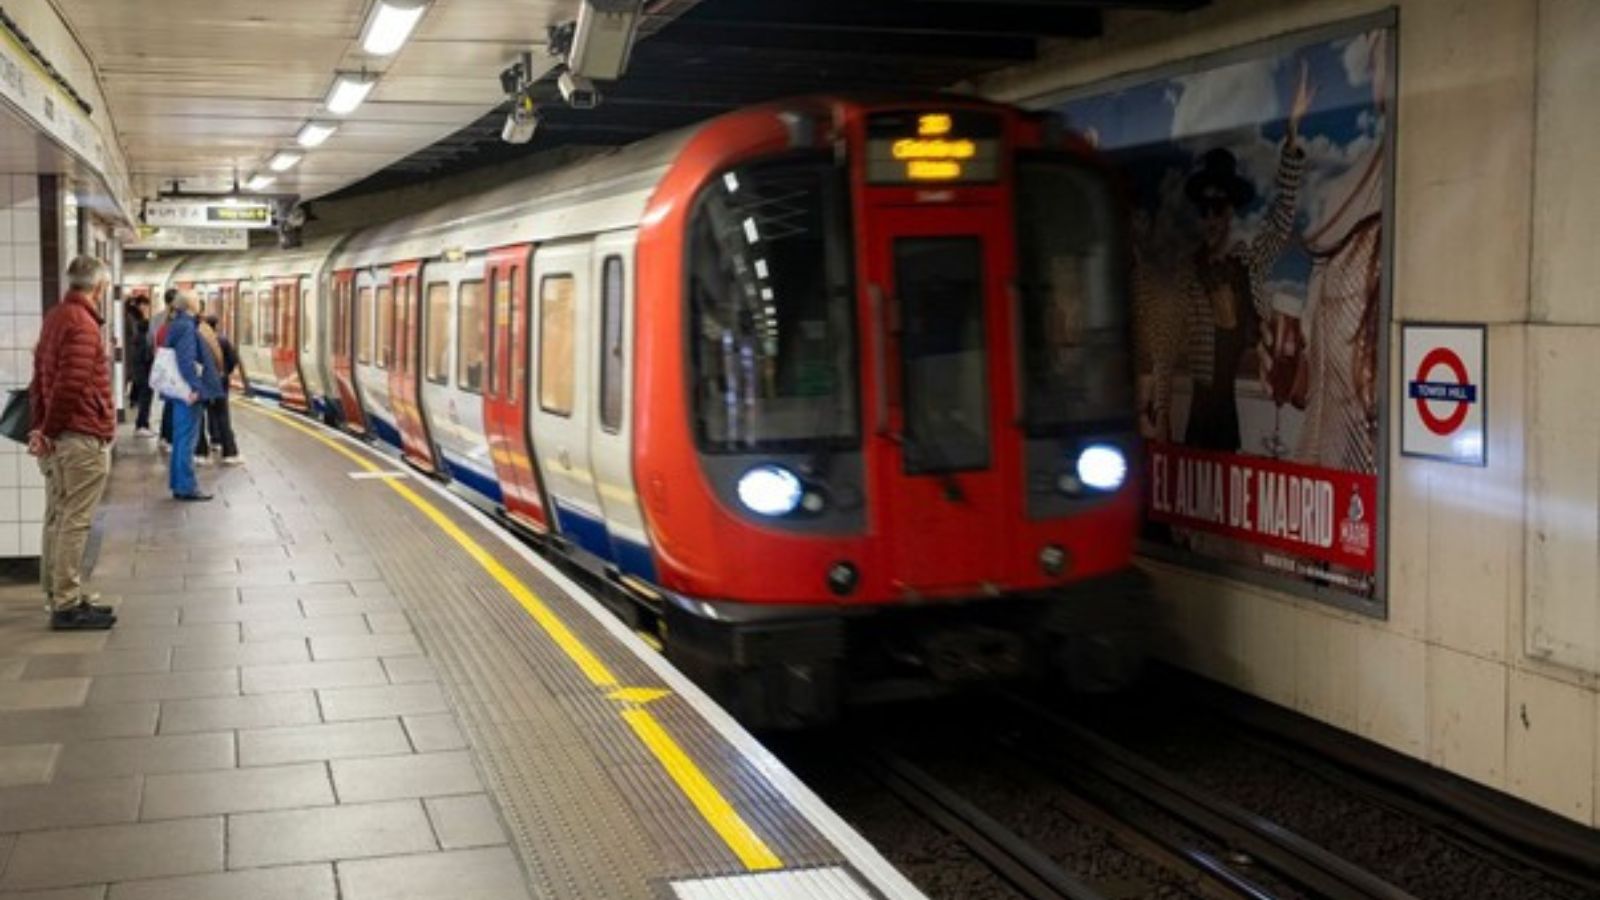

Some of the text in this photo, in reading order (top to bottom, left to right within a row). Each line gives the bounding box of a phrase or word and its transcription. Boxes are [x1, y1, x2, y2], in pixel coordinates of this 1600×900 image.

[1417, 385, 1468, 400] TOWER HILL
[1152, 453, 1334, 548] EL ALMA DE MADRID
